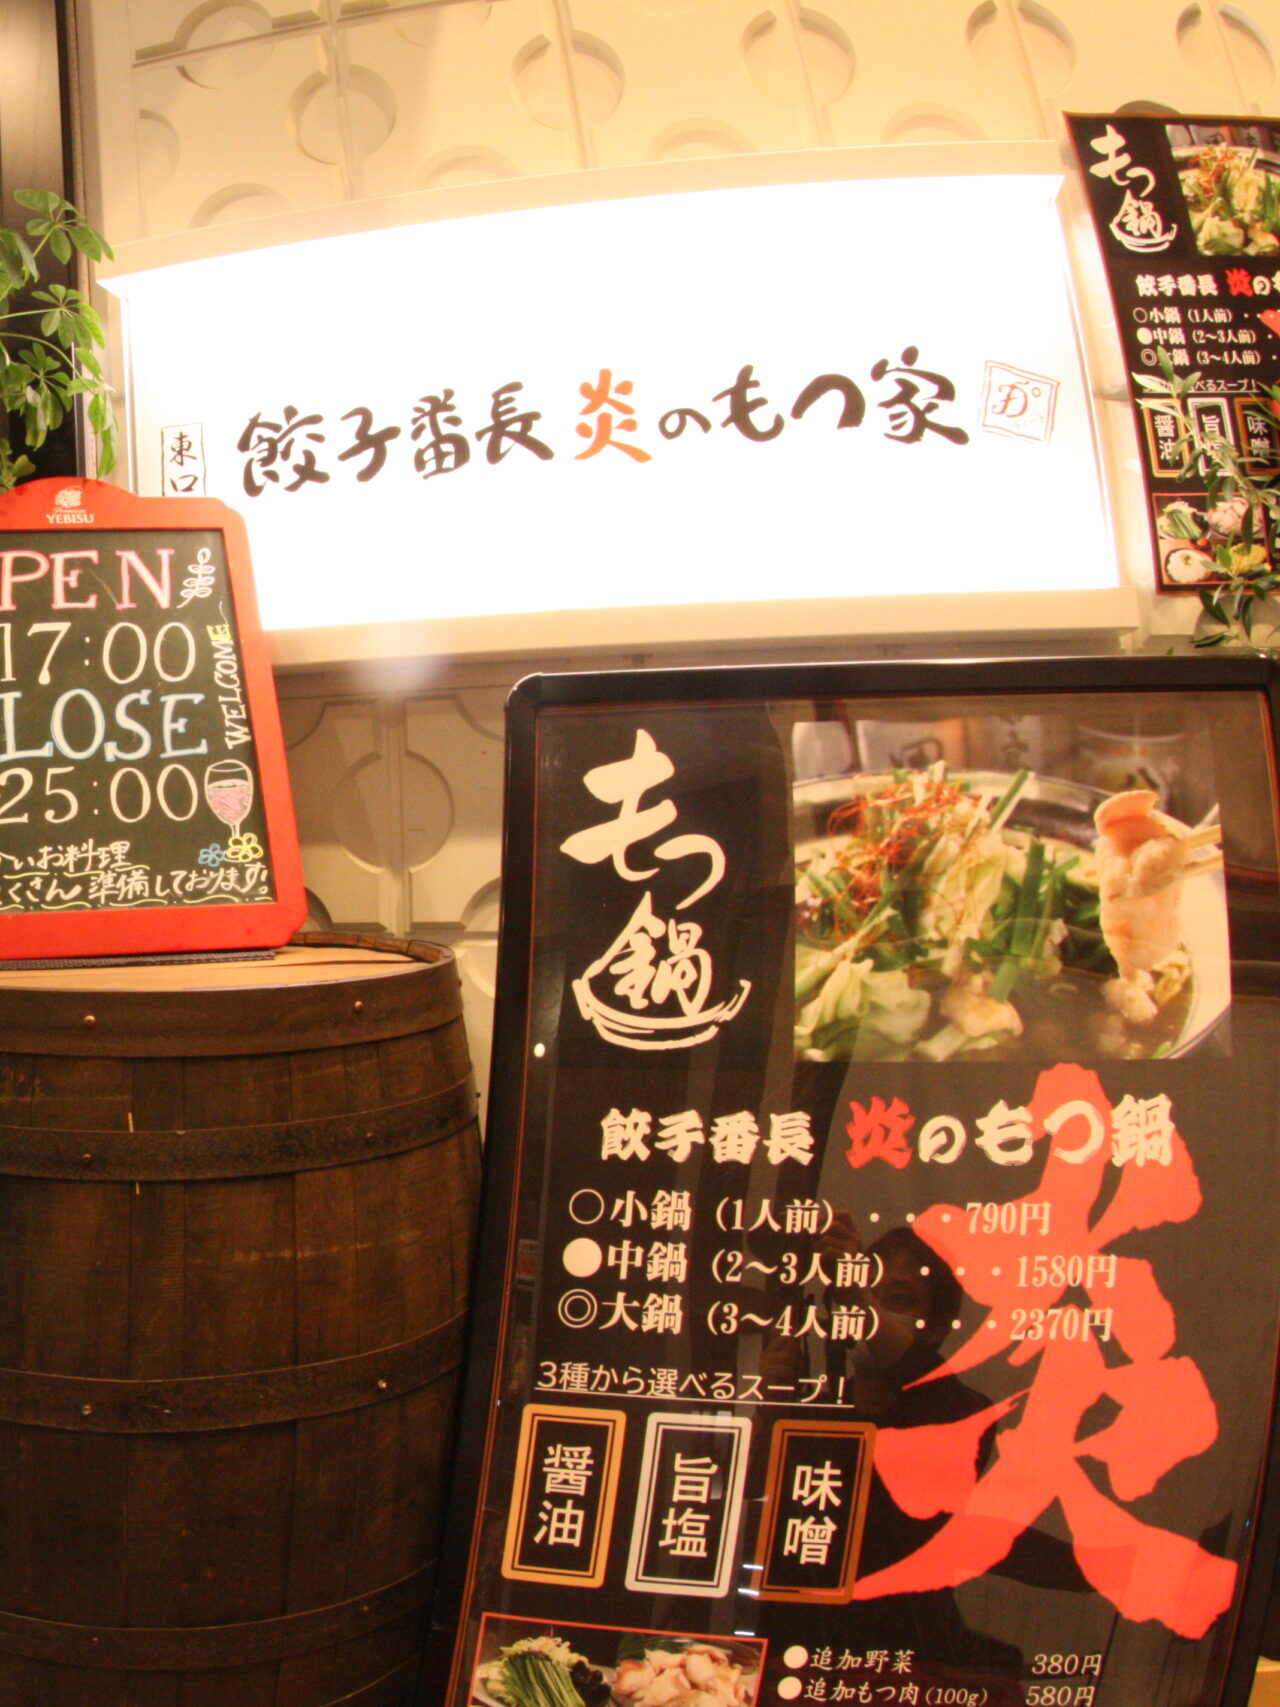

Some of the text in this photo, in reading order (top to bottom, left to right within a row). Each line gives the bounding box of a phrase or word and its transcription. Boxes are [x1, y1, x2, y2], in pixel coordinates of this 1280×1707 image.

[1225, 268, 1280, 296] 炎の
[168, 431, 199, 493] 東口
[46, 513, 95, 524] YEBISU
[207, 624, 251, 750] WELCOME
[560, 728, 752, 1051] もつ鍋
[600, 1094, 1174, 1170] 餃子番長 炎のもつ鍋
[966, 1201, 1052, 1237] 790円
[1015, 1254, 1117, 1289] 1580円
[1010, 1307, 1114, 1342] 2370円
[534, 1444, 595, 1548] 醤油
[659, 1453, 718, 1558] 旨塩
[783, 1460, 843, 1566] 味噌
[810, 1647, 1103, 1677] 追加野菜 380円
[1026, 1686, 1096, 1707] 580円
